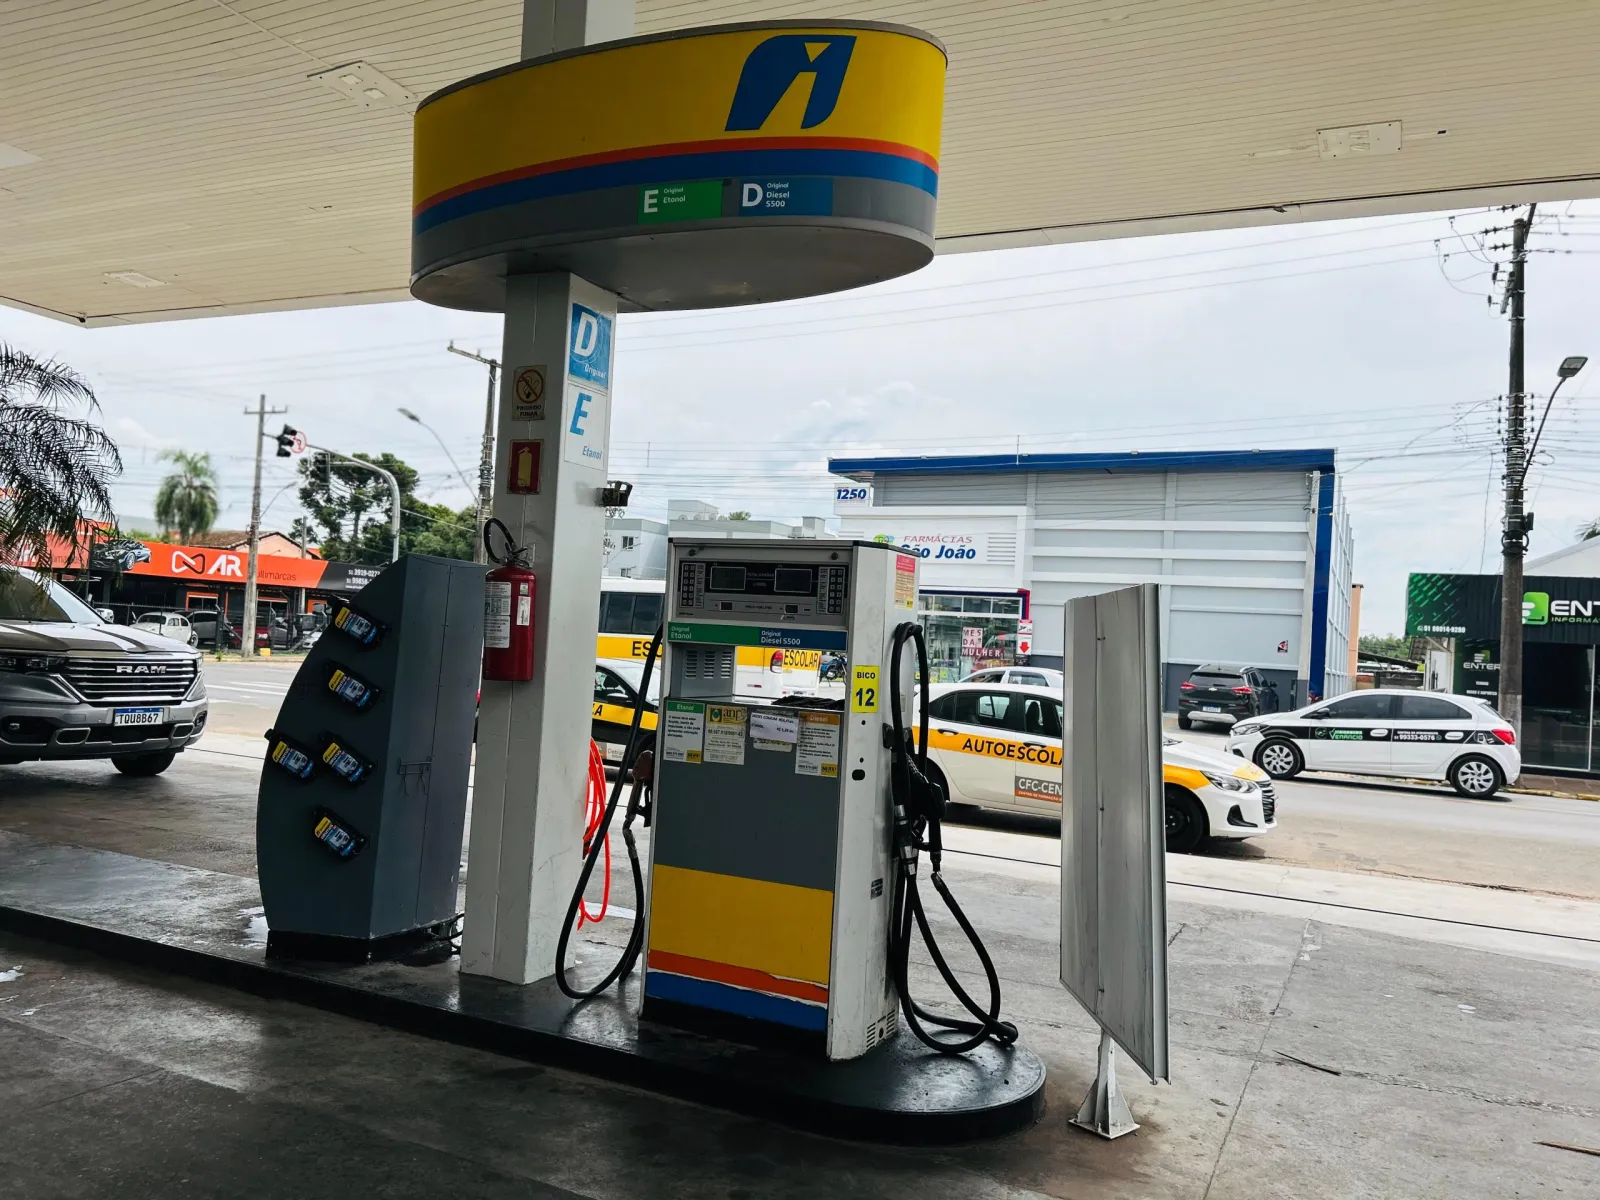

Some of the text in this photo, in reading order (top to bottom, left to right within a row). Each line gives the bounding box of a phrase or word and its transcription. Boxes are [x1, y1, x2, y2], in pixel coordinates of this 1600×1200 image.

[644, 190, 658, 214] E
[663, 195, 686, 204] Etanol
[742, 183, 764, 207] D
[574, 312, 598, 356] D
[585, 363, 607, 379] Original
[570, 392, 593, 436] E
[582, 445, 603, 460] Etanol
[837, 489, 866, 500] 1250
[904, 533, 972, 543] FARMÁCIAS
[935, 545, 976, 559] João
[207, 554, 243, 577] AR
[783, 649, 818, 668] ESCOLAR
[962, 648, 1000, 657] MULHER
[116, 666, 166, 674] RAM
[856, 688, 875, 706] 12
[119, 713, 159, 724] TQU8B67
[810, 714, 829, 722] Diesel
